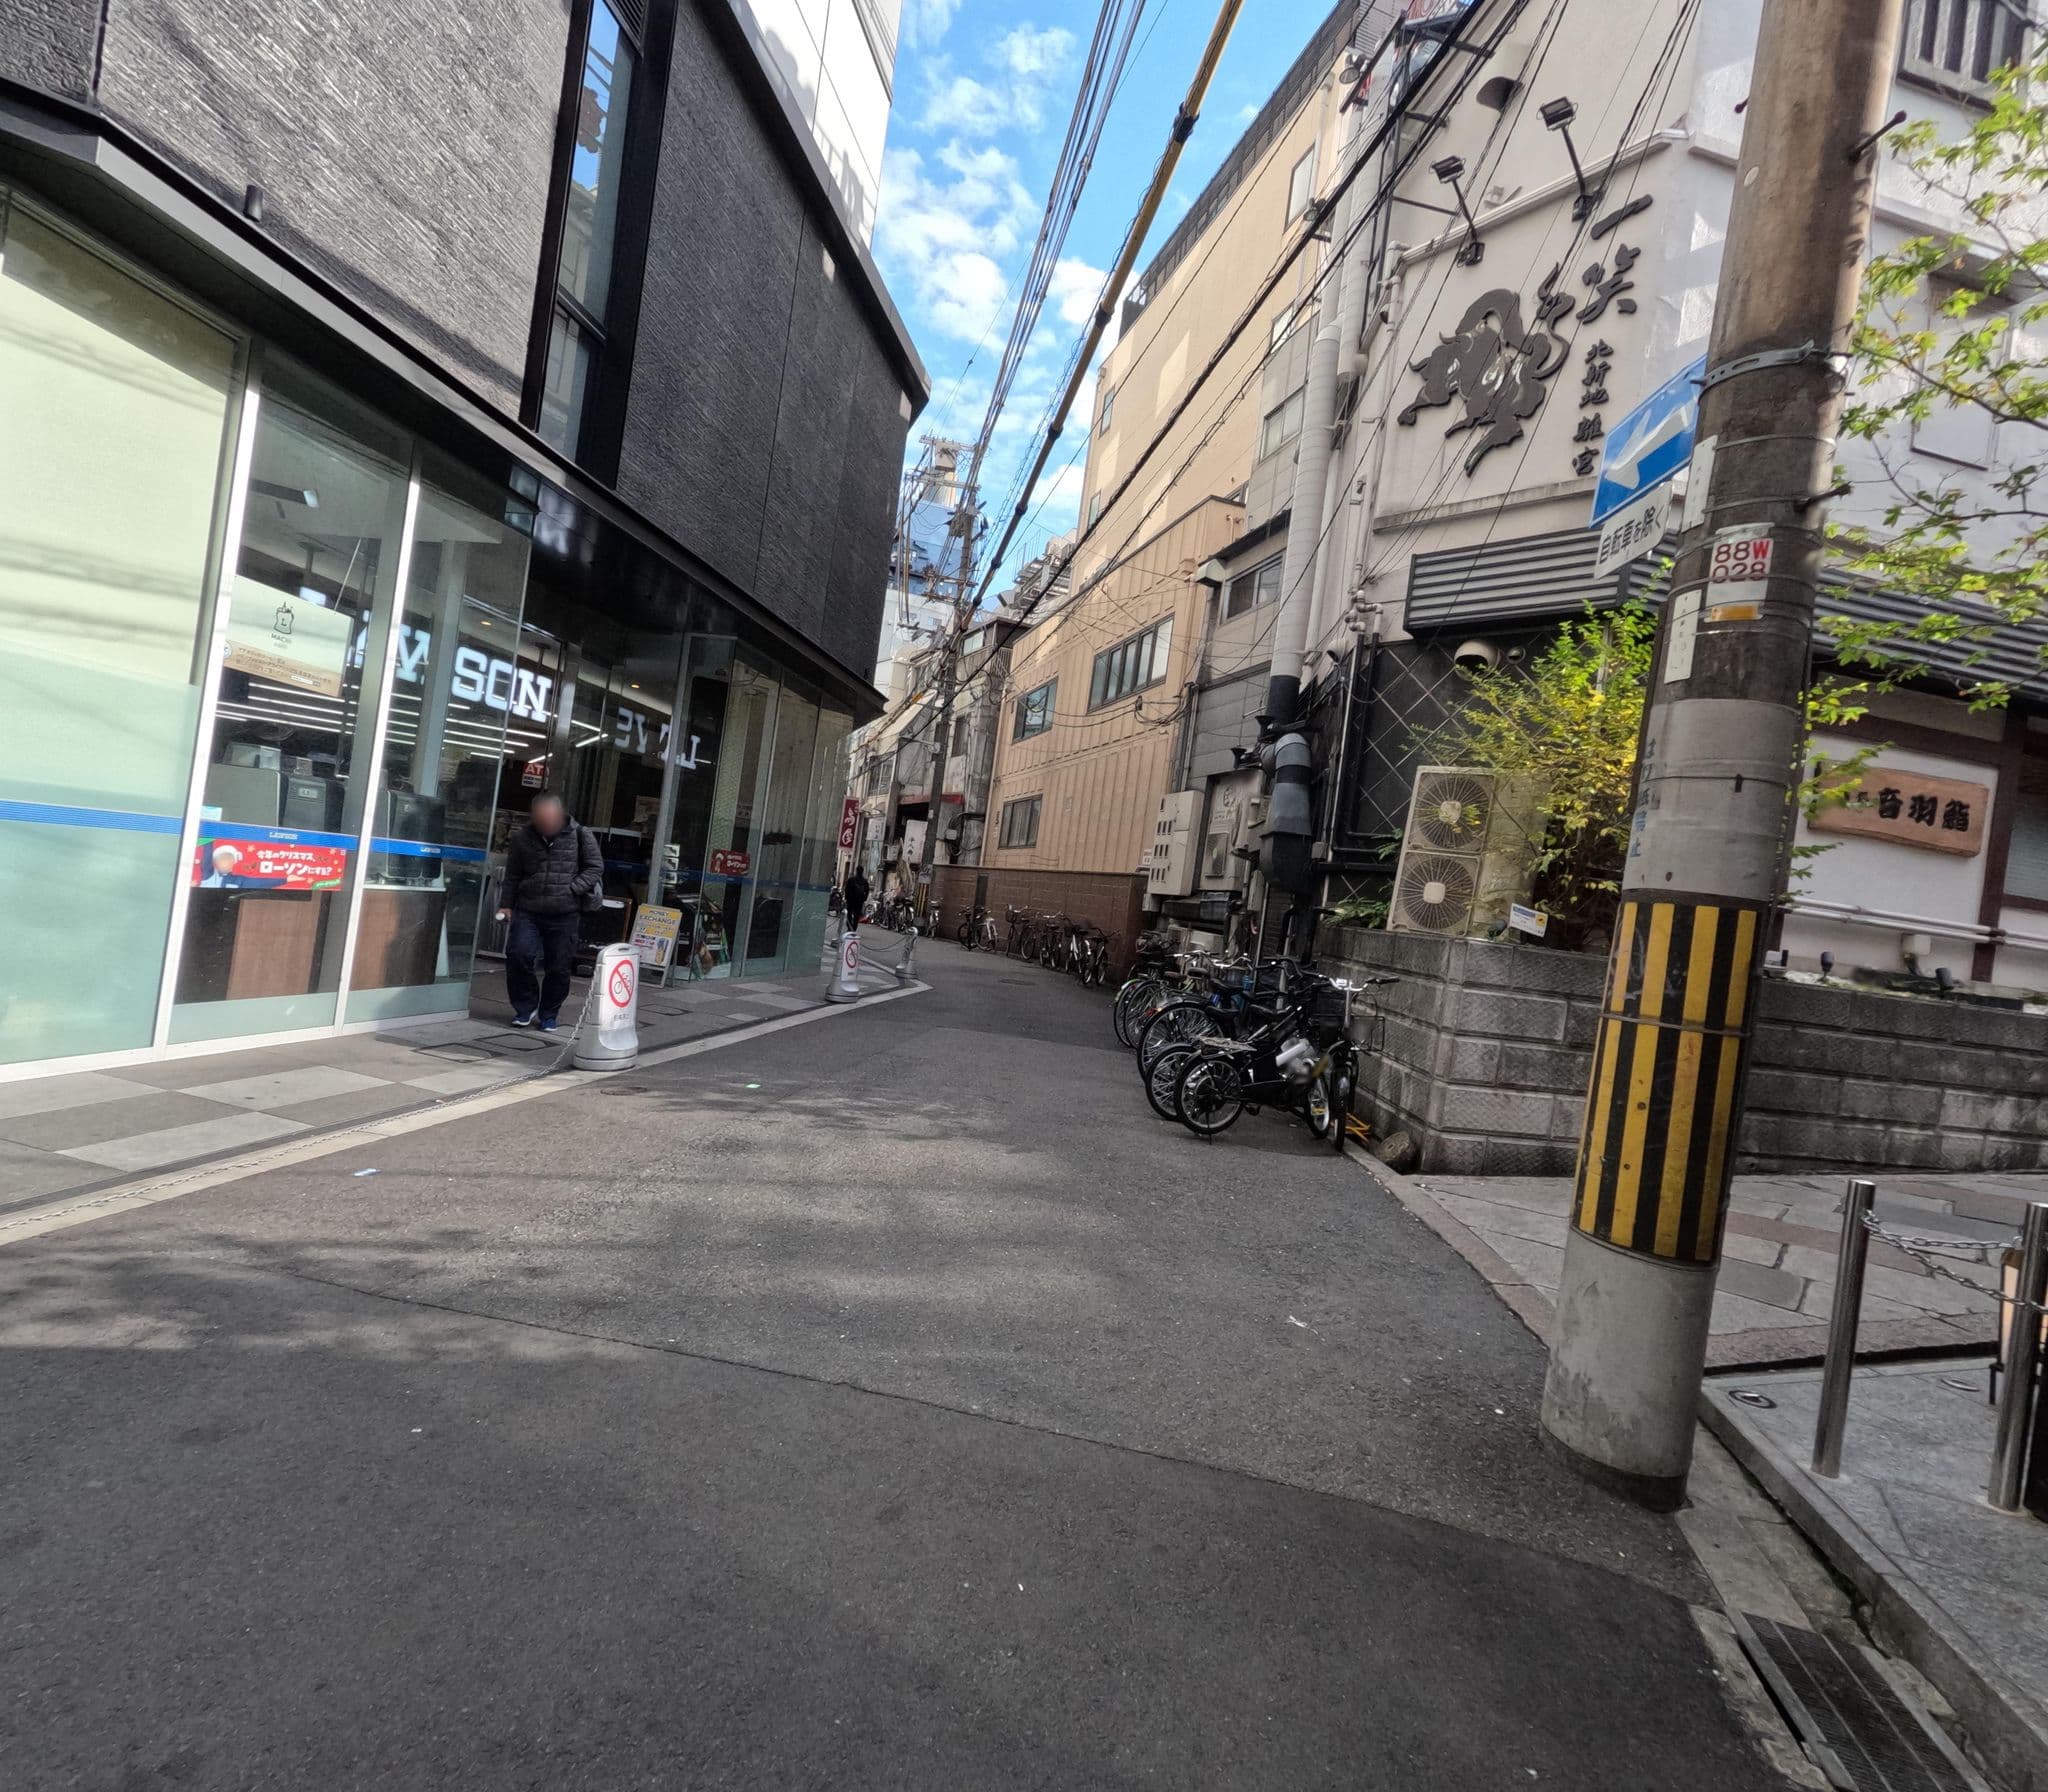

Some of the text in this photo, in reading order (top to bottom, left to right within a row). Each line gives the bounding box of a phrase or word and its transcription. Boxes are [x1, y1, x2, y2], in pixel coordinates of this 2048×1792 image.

[1571, 338, 1614, 476] 北新地離宮
[1599, 505, 1665, 563] 自転車を除く
[1715, 540, 1770, 564] 88W
[1711, 562, 1767, 584] 028
